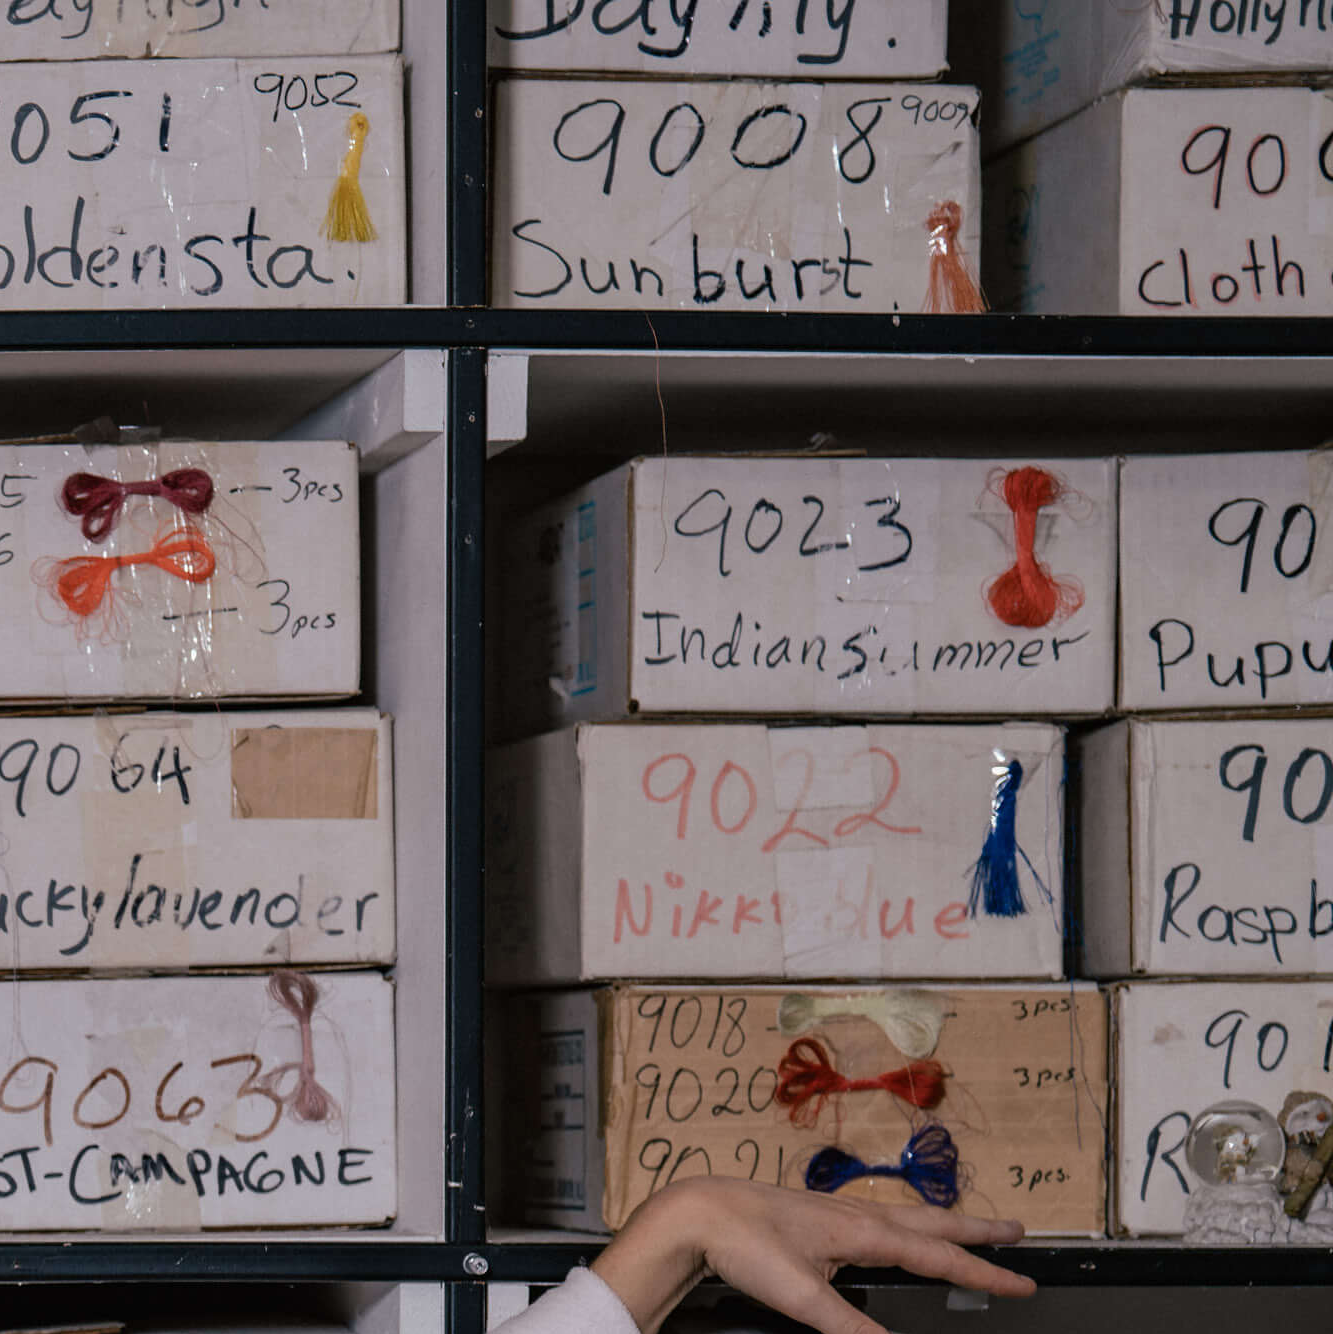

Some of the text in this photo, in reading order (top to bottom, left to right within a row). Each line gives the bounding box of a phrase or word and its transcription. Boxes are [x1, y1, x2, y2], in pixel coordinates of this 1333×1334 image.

[253, 71, 363, 122] 9052
[553, 97, 893, 195] 9008
[1181, 123, 1333, 209] 90
[511, 219, 873, 302] Sunburst
[673, 488, 915, 578] 9023
[641, 746, 923, 853] 9022
[637, 995, 749, 1058] 9018
[635, 1062, 779, 1122] 9020
